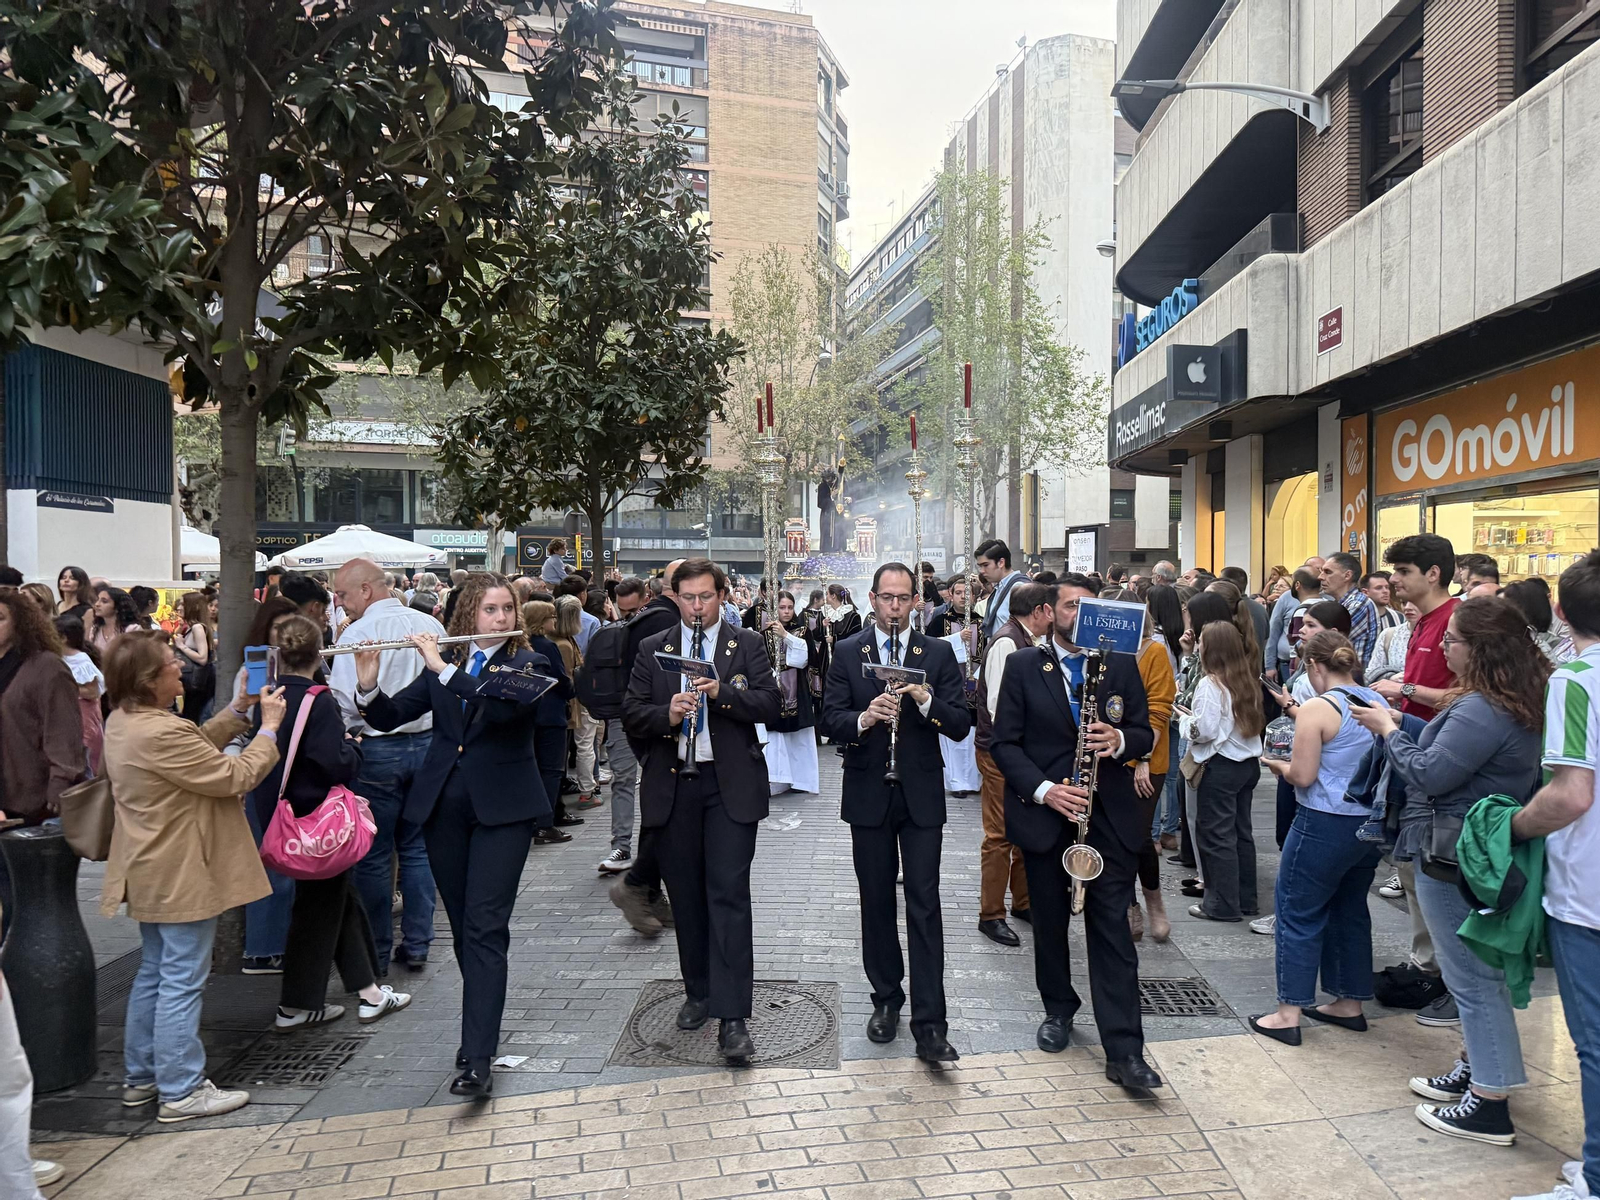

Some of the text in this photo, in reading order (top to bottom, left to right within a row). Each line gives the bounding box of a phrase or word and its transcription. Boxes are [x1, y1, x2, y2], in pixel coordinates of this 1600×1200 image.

[1136, 278, 1197, 353] SEGUROS
[1327, 317, 1337, 327] Calle
[1320, 327, 1340, 343] Cruz Conde
[1116, 401, 1166, 448] Rossellimac
[1391, 381, 1575, 482] GOmóvil
[263, 535, 297, 544] ÓPTICO
[431, 532, 488, 545] otoaudio
[298, 557, 324, 565] PEPSI
